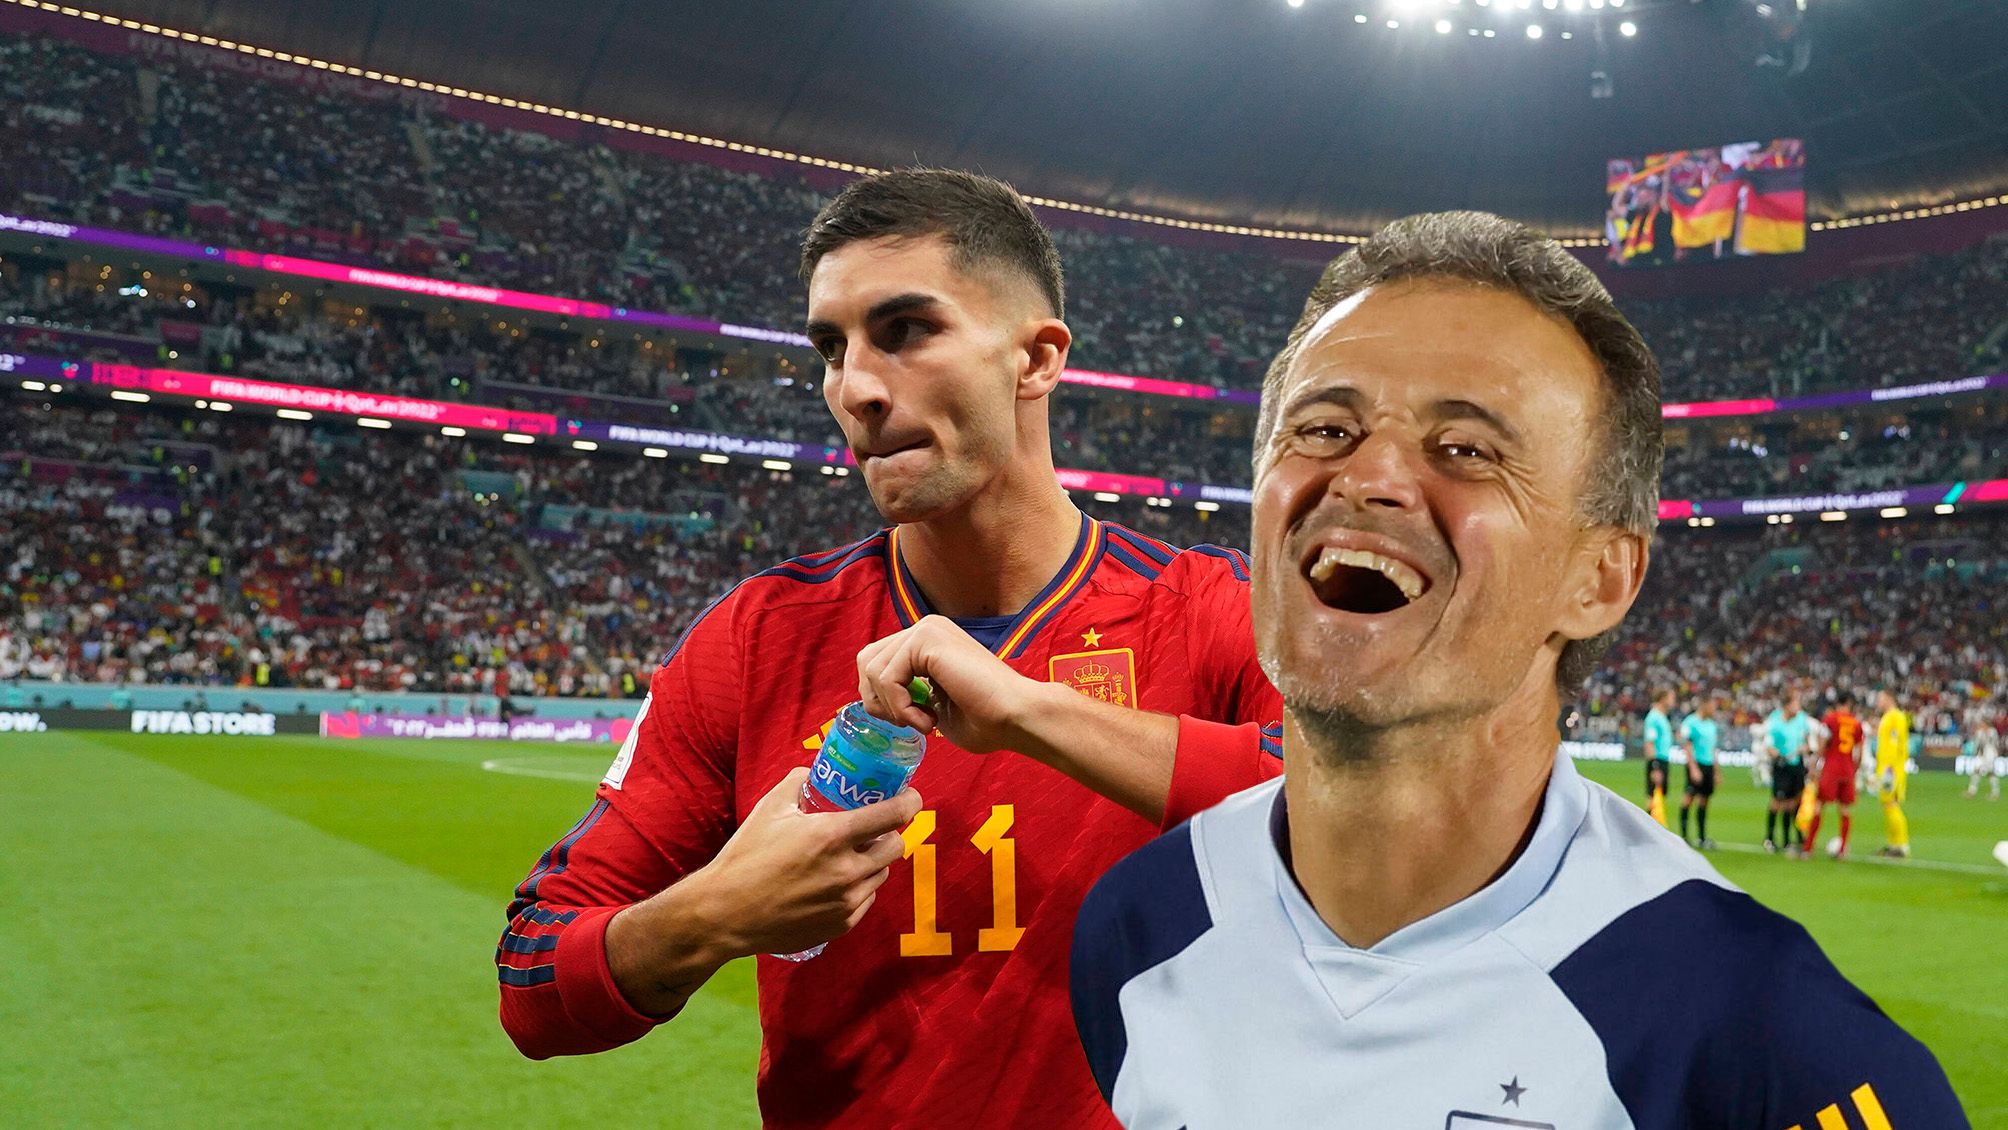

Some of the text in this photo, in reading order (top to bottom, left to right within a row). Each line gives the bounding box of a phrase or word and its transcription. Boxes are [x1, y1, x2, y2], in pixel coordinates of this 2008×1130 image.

[131, 710, 276, 735] FIFA STORE
[1837, 716, 1856, 753] 5
[817, 759, 885, 805] arwa
[900, 804, 1027, 956] 11
